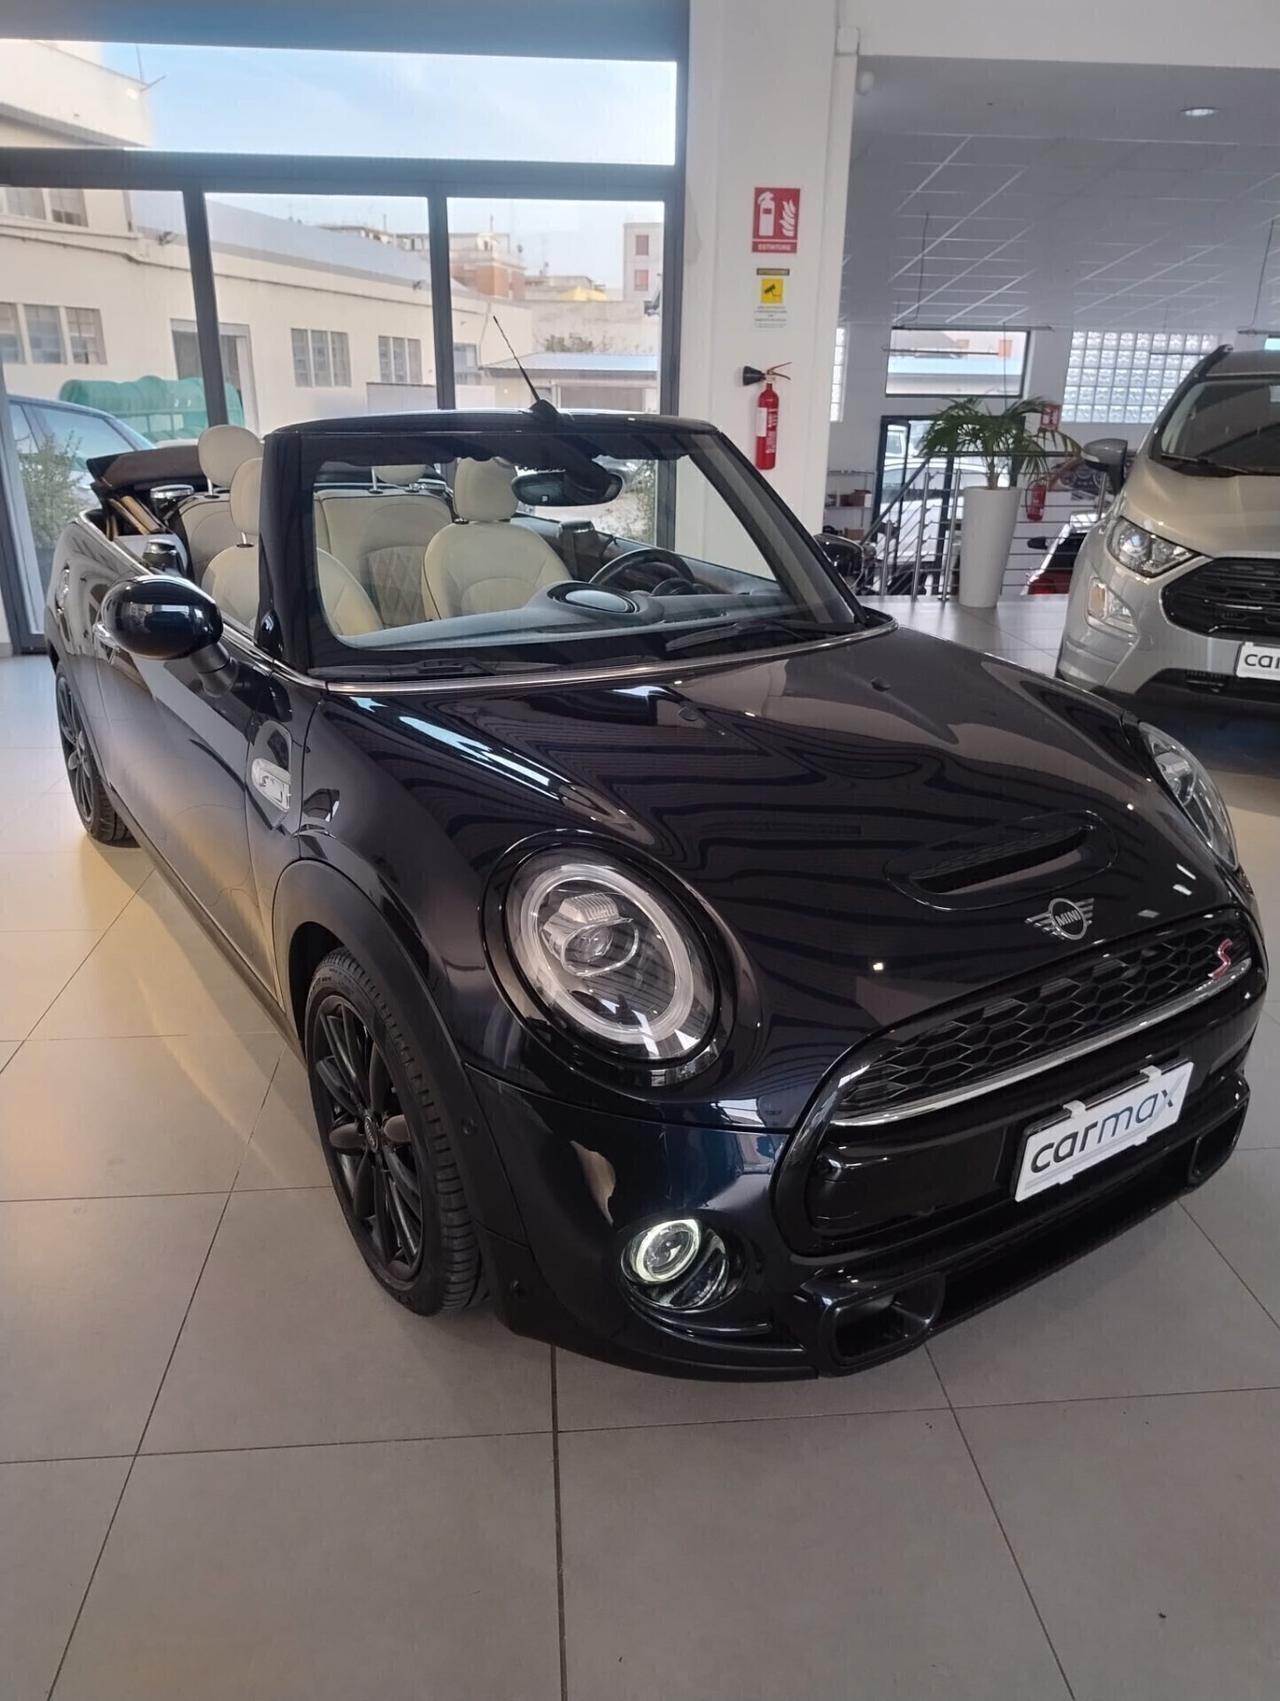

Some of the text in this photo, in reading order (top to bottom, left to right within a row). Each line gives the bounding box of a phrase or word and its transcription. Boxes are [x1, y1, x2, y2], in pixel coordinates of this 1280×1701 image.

[1055, 909, 1081, 926] MINI
[1207, 938, 1233, 983] S
[1030, 1080, 1182, 1173] carmax
